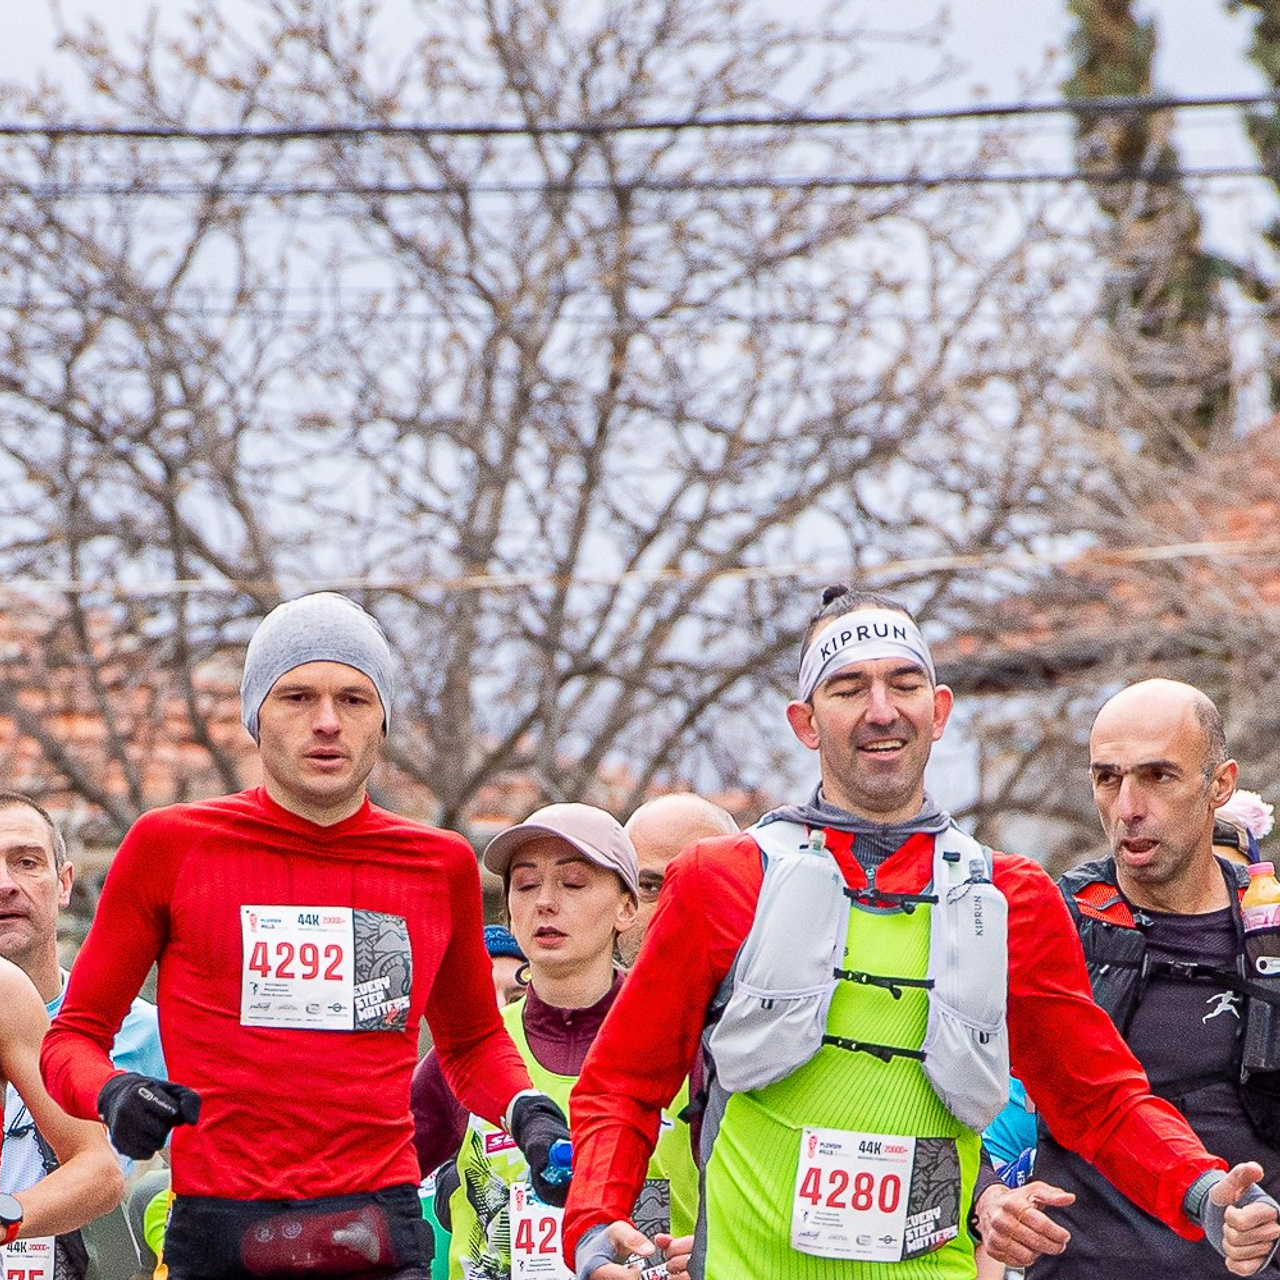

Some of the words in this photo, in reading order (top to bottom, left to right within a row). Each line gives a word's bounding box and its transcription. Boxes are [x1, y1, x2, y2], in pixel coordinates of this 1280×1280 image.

[820, 623, 907, 661] KIPRUN
[297, 913, 320, 926] 44K
[973, 896, 984, 936] KIPRUN
[249, 942, 343, 981] 4292
[354, 975, 391, 996] EVERY
[355, 991, 385, 1009] STEP
[858, 1140, 882, 1155] 44K
[799, 1167, 901, 1213] 4280
[905, 1206, 942, 1228] EVERY
[515, 1217, 557, 1255] 42
[905, 1221, 936, 1243] STEP
[6, 1241, 27, 1253] 44K
